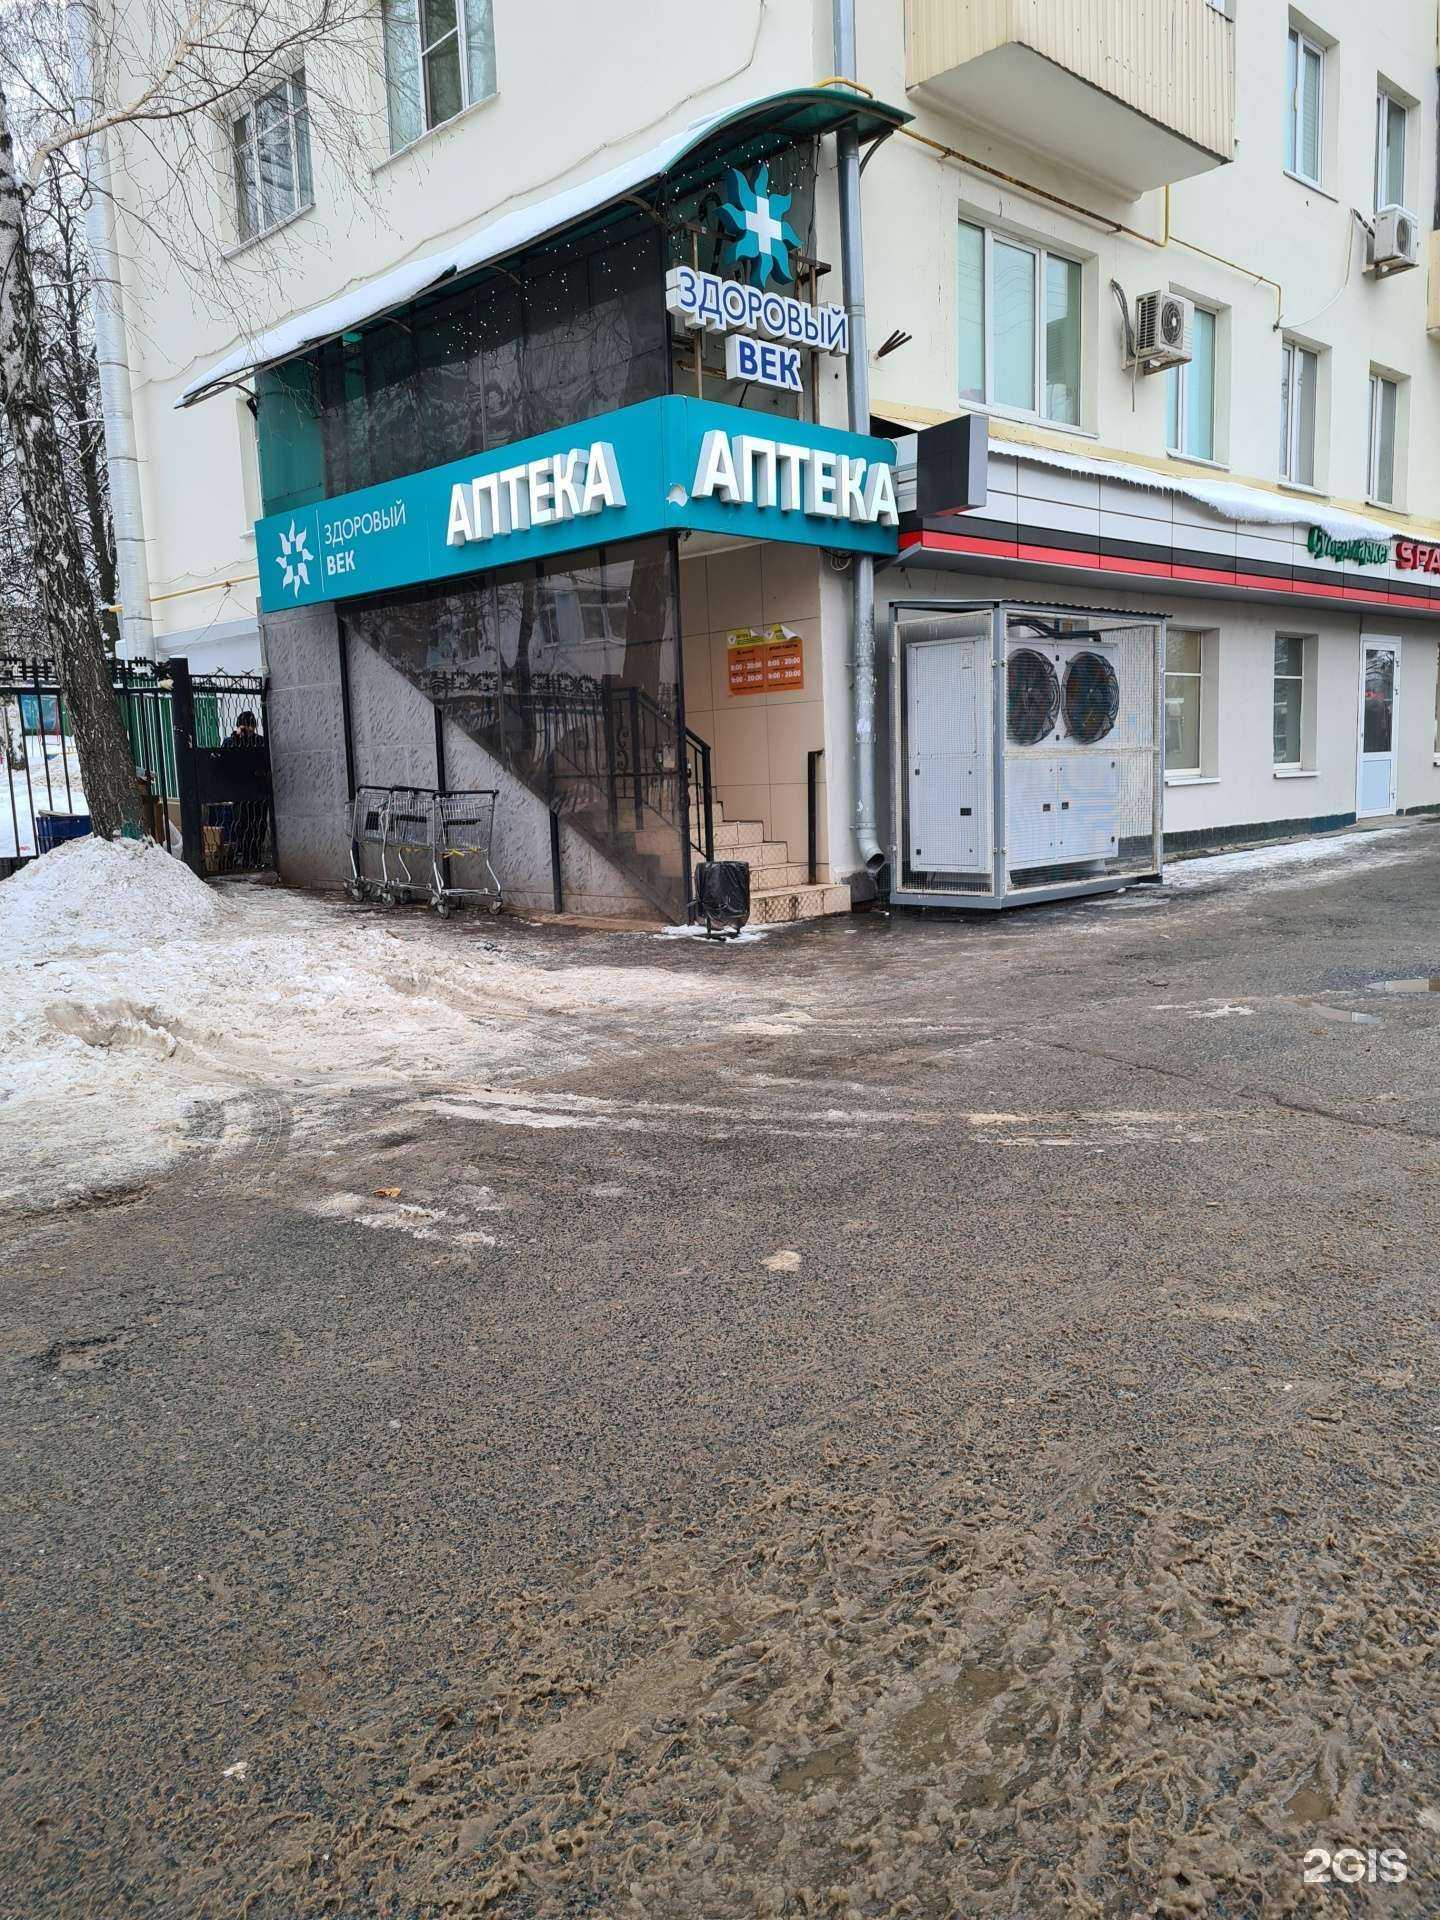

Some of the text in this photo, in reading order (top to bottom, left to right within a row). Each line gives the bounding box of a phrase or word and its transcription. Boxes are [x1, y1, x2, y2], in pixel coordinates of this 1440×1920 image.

[674, 267, 849, 354] ЗДОРОВЫЙ
[735, 338, 802, 390] ВЕК
[446, 441, 627, 547] АПТЕКА
[690, 429, 900, 526] АПТЕКА
[324, 499, 406, 547] ЗДОРОВЫЙ
[326, 549, 357, 576] ВЕК
